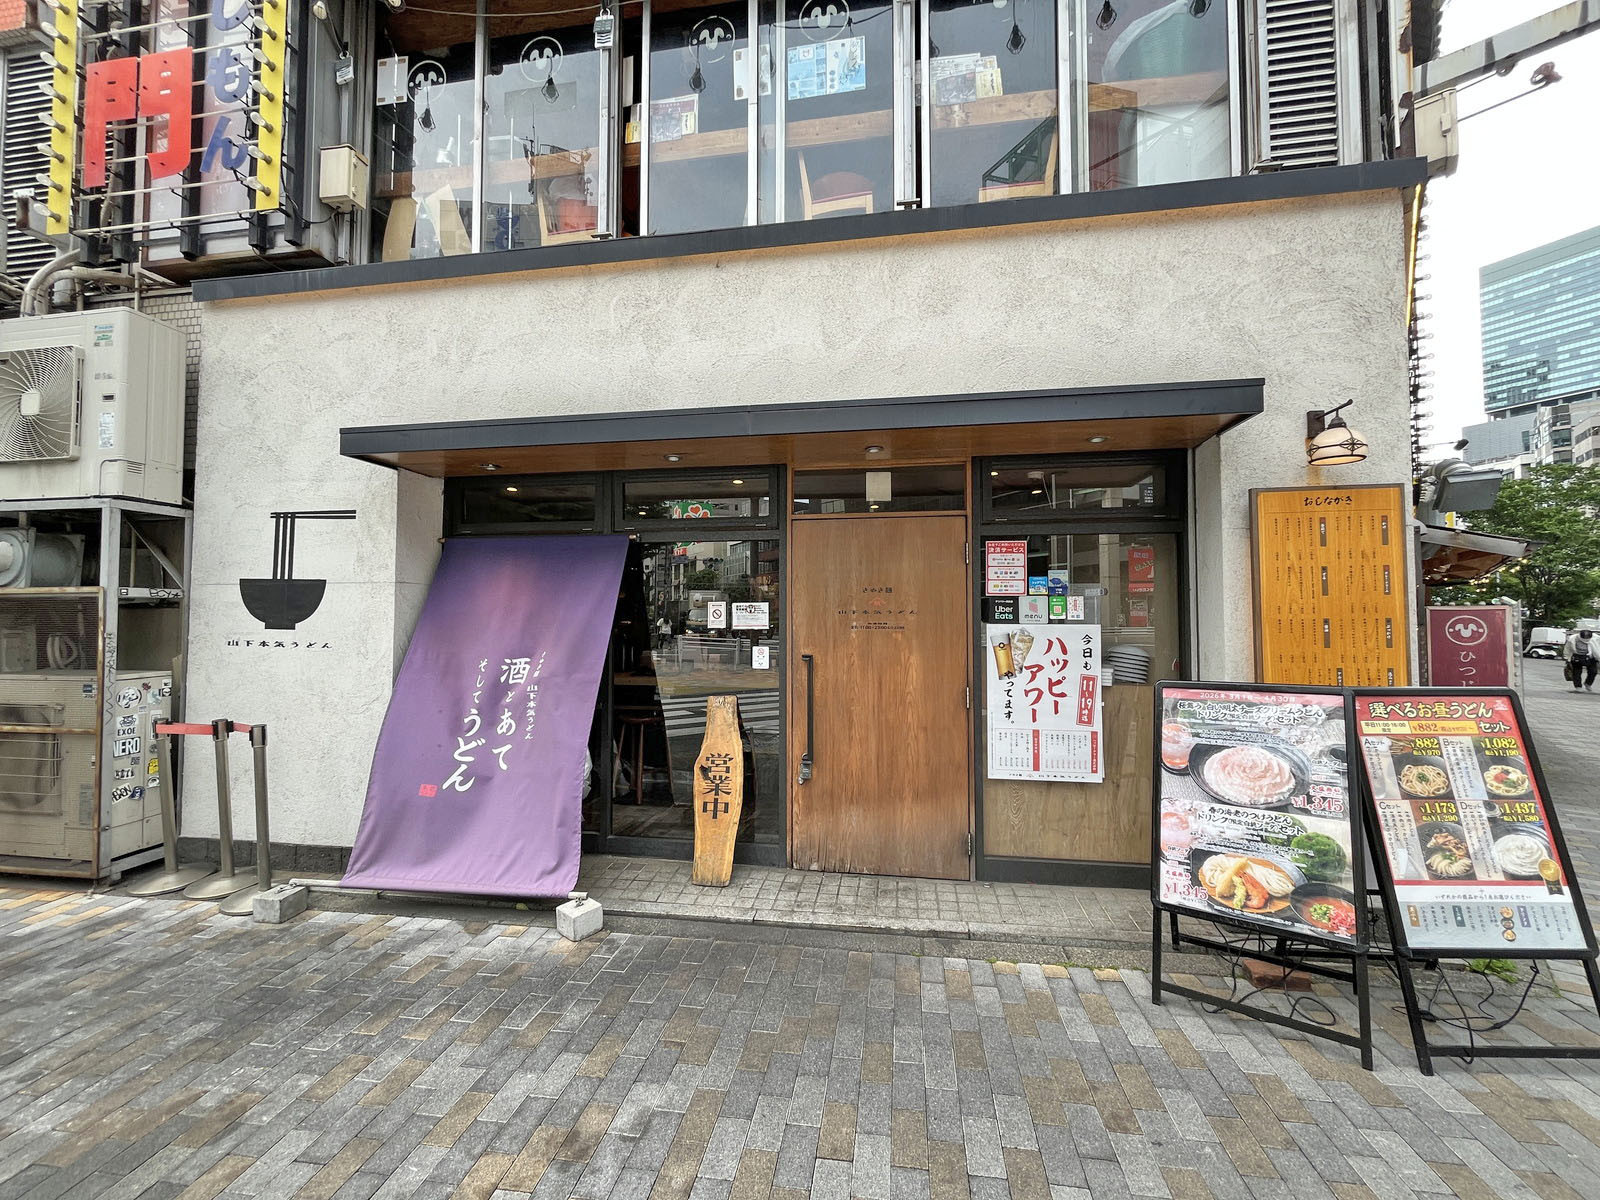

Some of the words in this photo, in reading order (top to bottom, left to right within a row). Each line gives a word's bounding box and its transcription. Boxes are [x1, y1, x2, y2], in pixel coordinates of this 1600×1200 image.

[1303, 495, 1353, 507] おしながき
[227, 639, 333, 649] 山下本気うどん
[1082, 633, 1093, 671] 今日も
[1043, 637, 1069, 715] ハッピー
[1004, 670, 1017, 724] やってます。
[1024, 663, 1045, 723] アワー
[492, 657, 531, 771] 酒とあて
[525, 684, 538, 740] 山下本気うどん
[1368, 701, 1493, 719] 選べるお昼うどん
[442, 658, 488, 792] そしてうどん
[1479, 721, 1511, 733] セット
[1364, 738, 1385, 746] Aセット
[1411, 737, 1440, 748] ¥882
[1443, 738, 1464, 746] Bセット
[702, 752, 734, 820] 営業中
[1379, 801, 1401, 810] Cセット
[1460, 801, 1482, 810] Dセット
[1208, 806, 1292, 825] 春の海老のつけうどん
